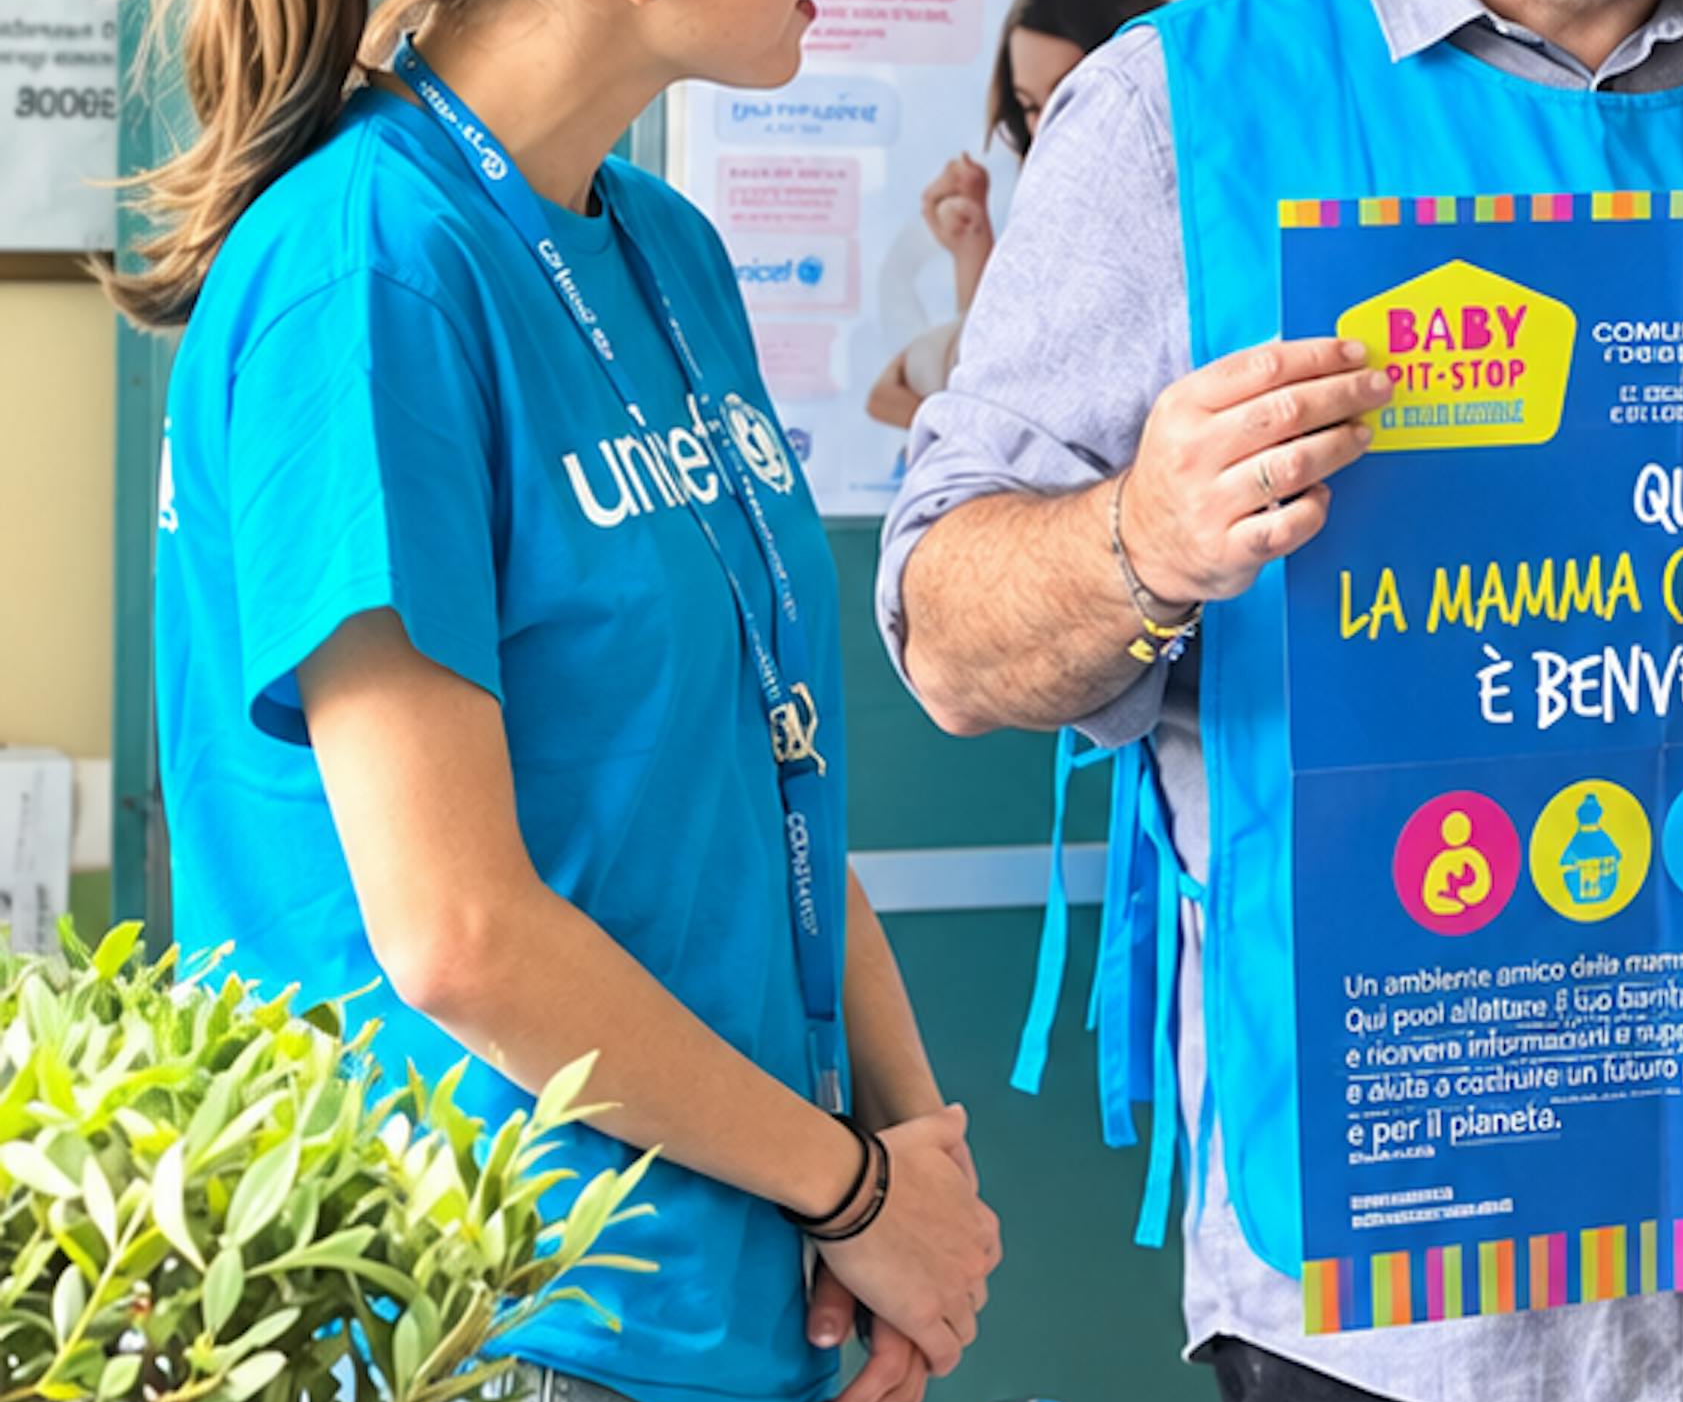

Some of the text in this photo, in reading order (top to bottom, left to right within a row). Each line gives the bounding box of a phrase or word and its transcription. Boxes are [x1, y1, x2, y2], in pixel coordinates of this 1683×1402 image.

[1387, 304, 1527, 354] BABY
[1386, 358, 1526, 392] PIT-STOP
[1339, 567, 1408, 641] LA
[1426, 551, 1642, 633] MAMMA
[1476, 646, 1514, 724] È
[1345, 974, 1379, 999] Un
[1346, 1003, 1388, 1040] Qui
[1345, 1049, 1361, 1068] e
[1347, 1125, 1364, 1146] e
[1372, 1121, 1420, 1154] per
